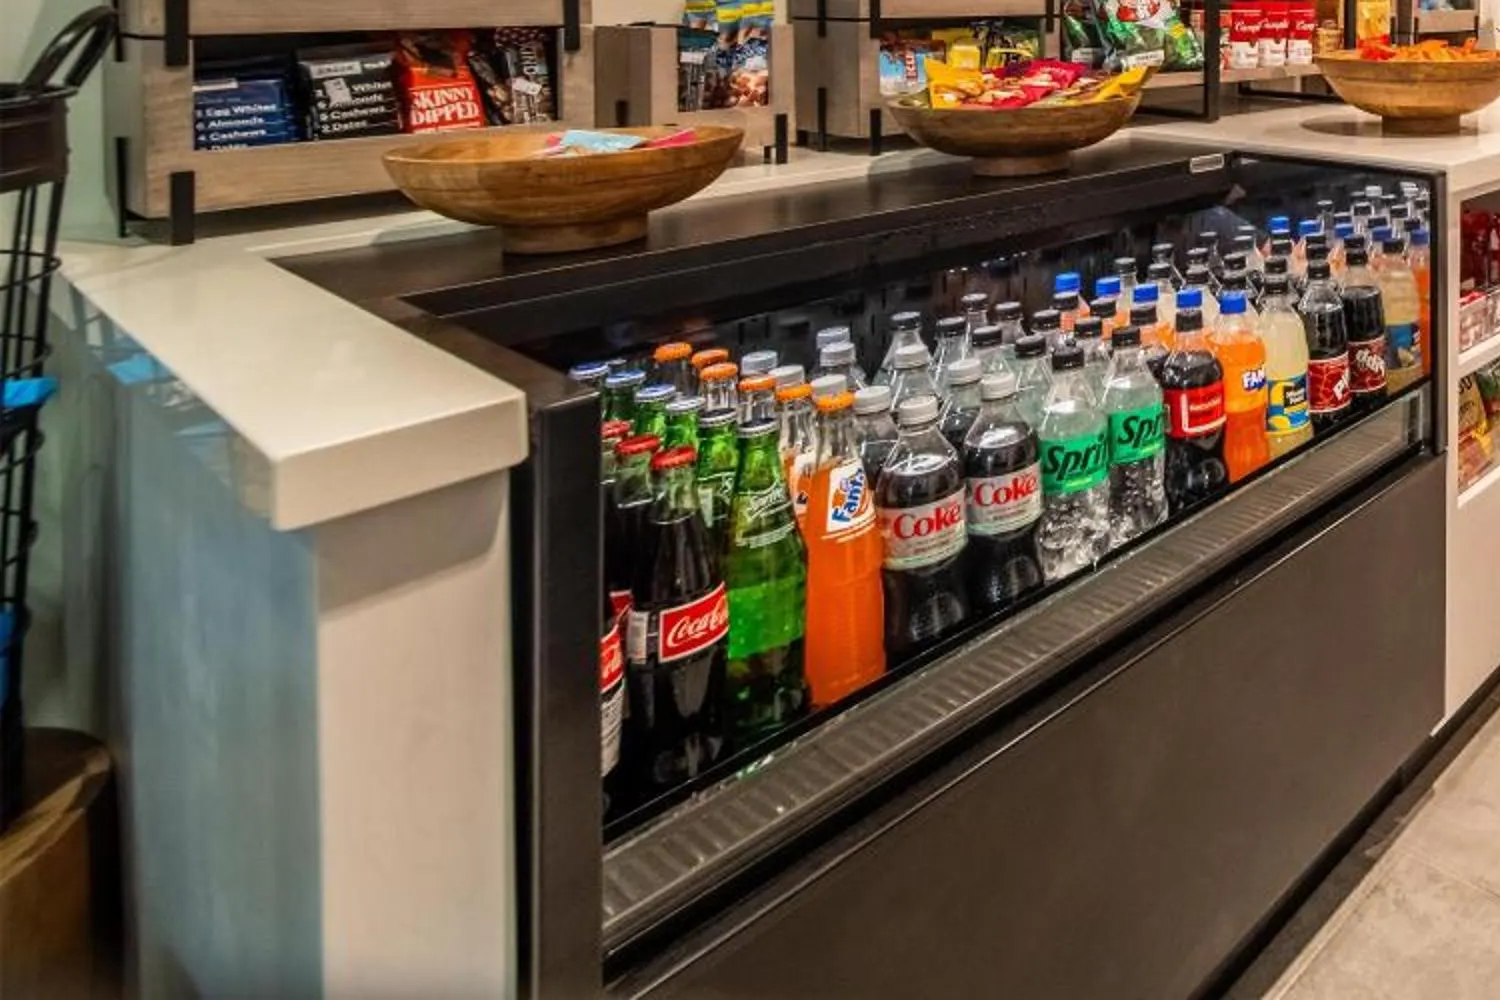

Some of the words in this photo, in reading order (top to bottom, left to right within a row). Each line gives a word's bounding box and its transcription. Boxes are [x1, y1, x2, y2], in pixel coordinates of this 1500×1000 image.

[413, 87, 474, 110] SKINNY
[411, 101, 480, 126] DIPPED
[975, 475, 1037, 506] Coke
[893, 503, 961, 540] Coke
